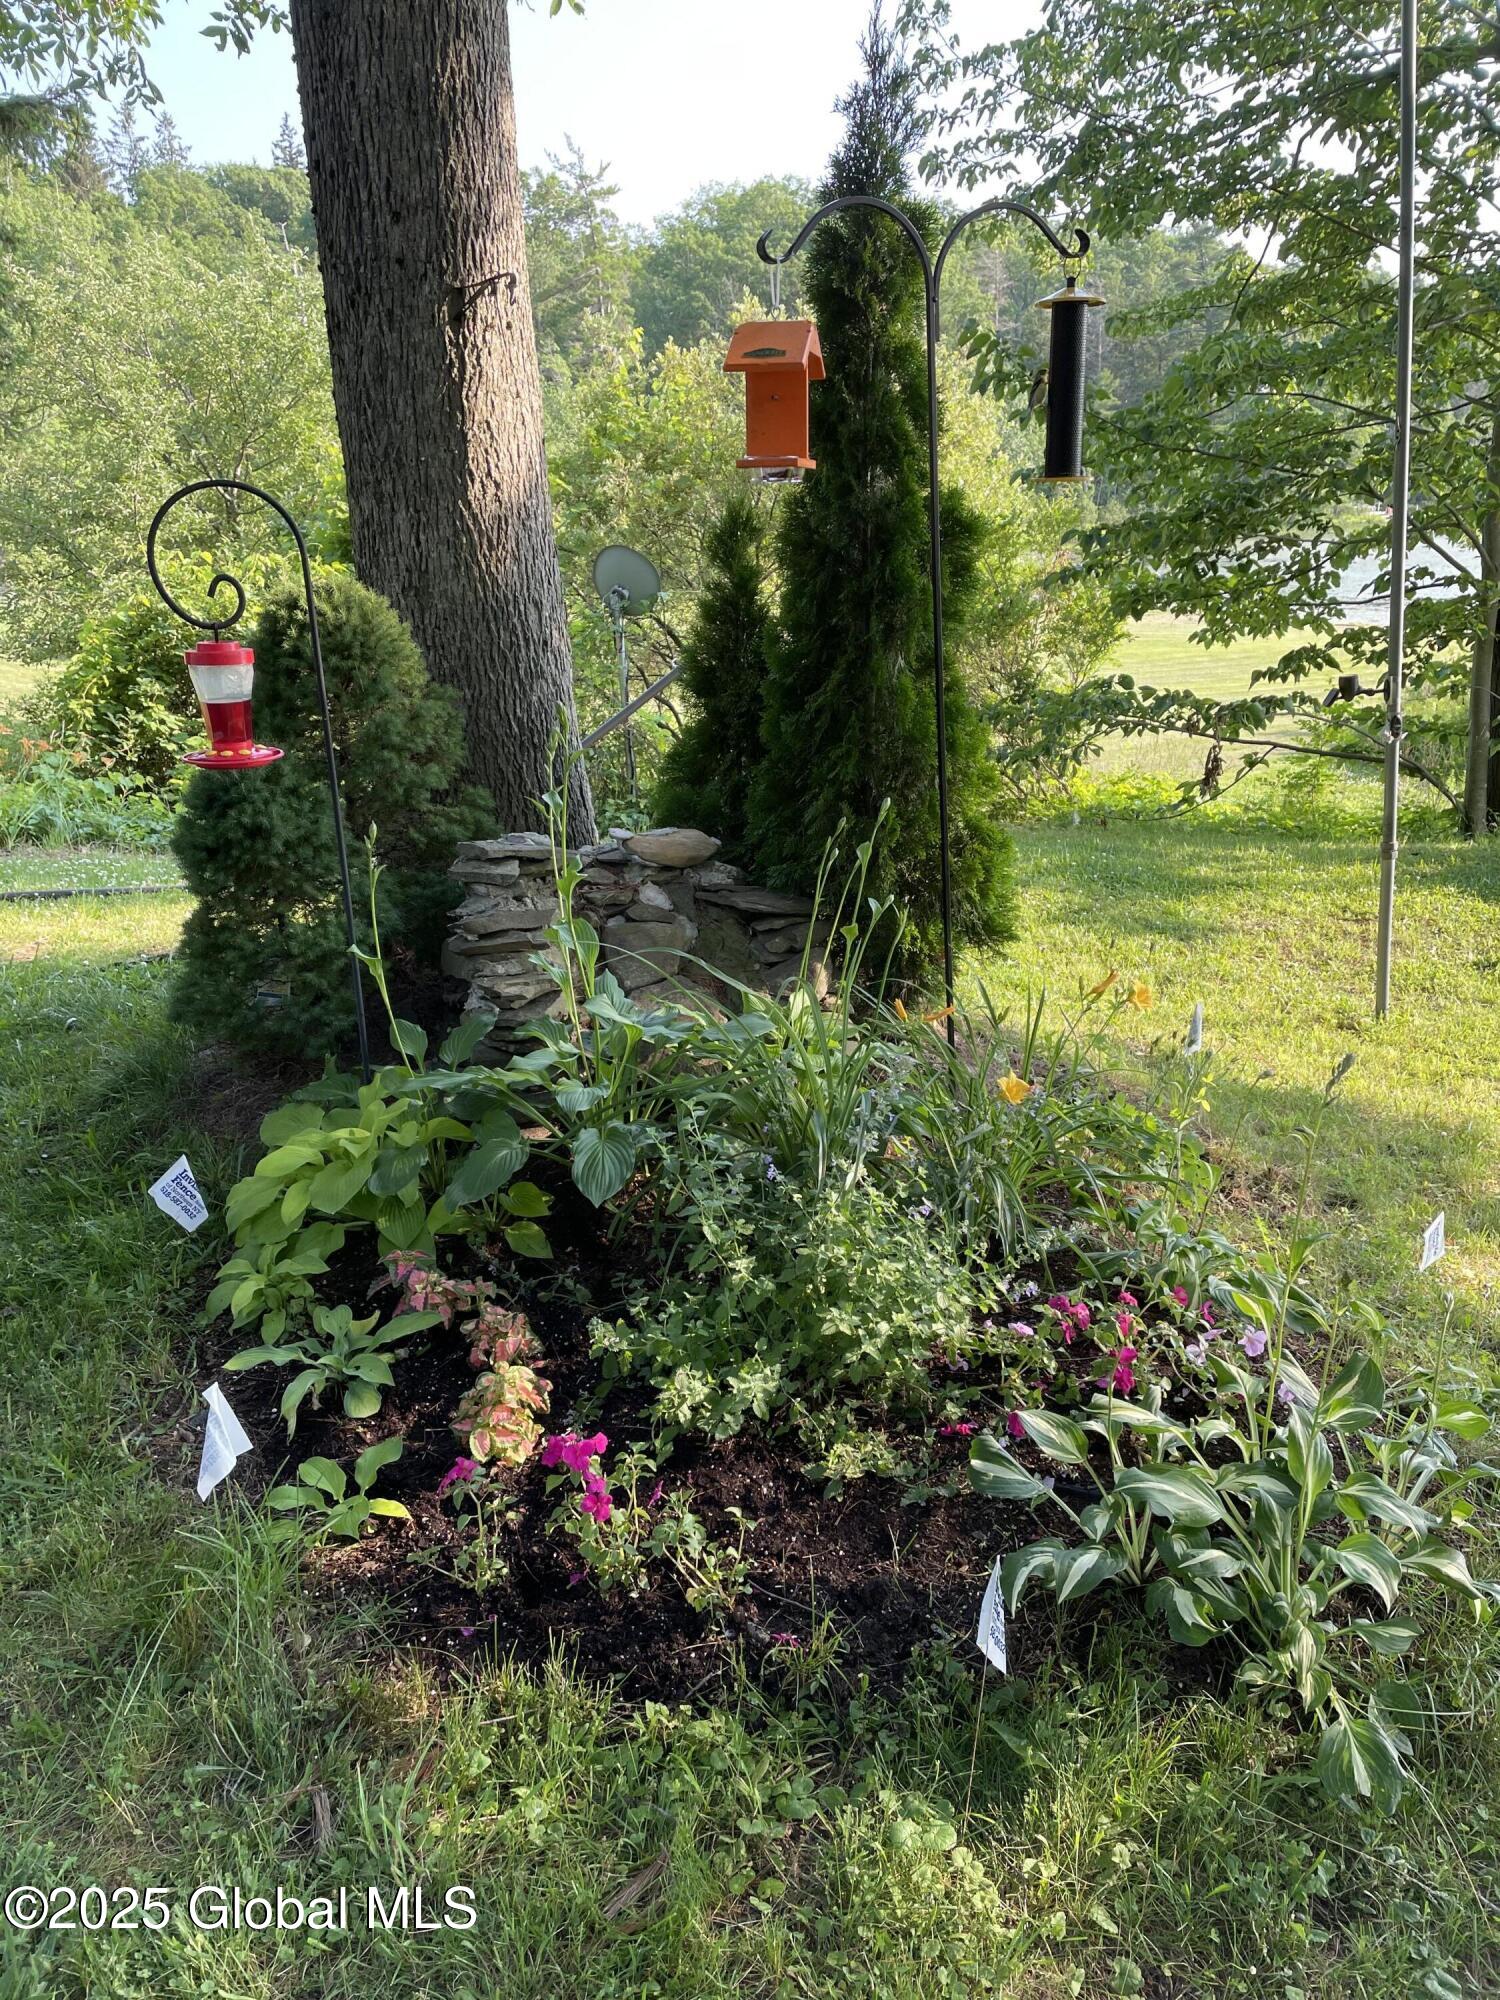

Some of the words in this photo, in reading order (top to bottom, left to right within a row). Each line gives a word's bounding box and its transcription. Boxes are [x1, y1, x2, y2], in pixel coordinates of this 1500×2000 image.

[171, 1175, 197, 1200] Fence
[160, 1186, 197, 1220] 518-587-0032
[191, 1205, 202, 1215] NY
